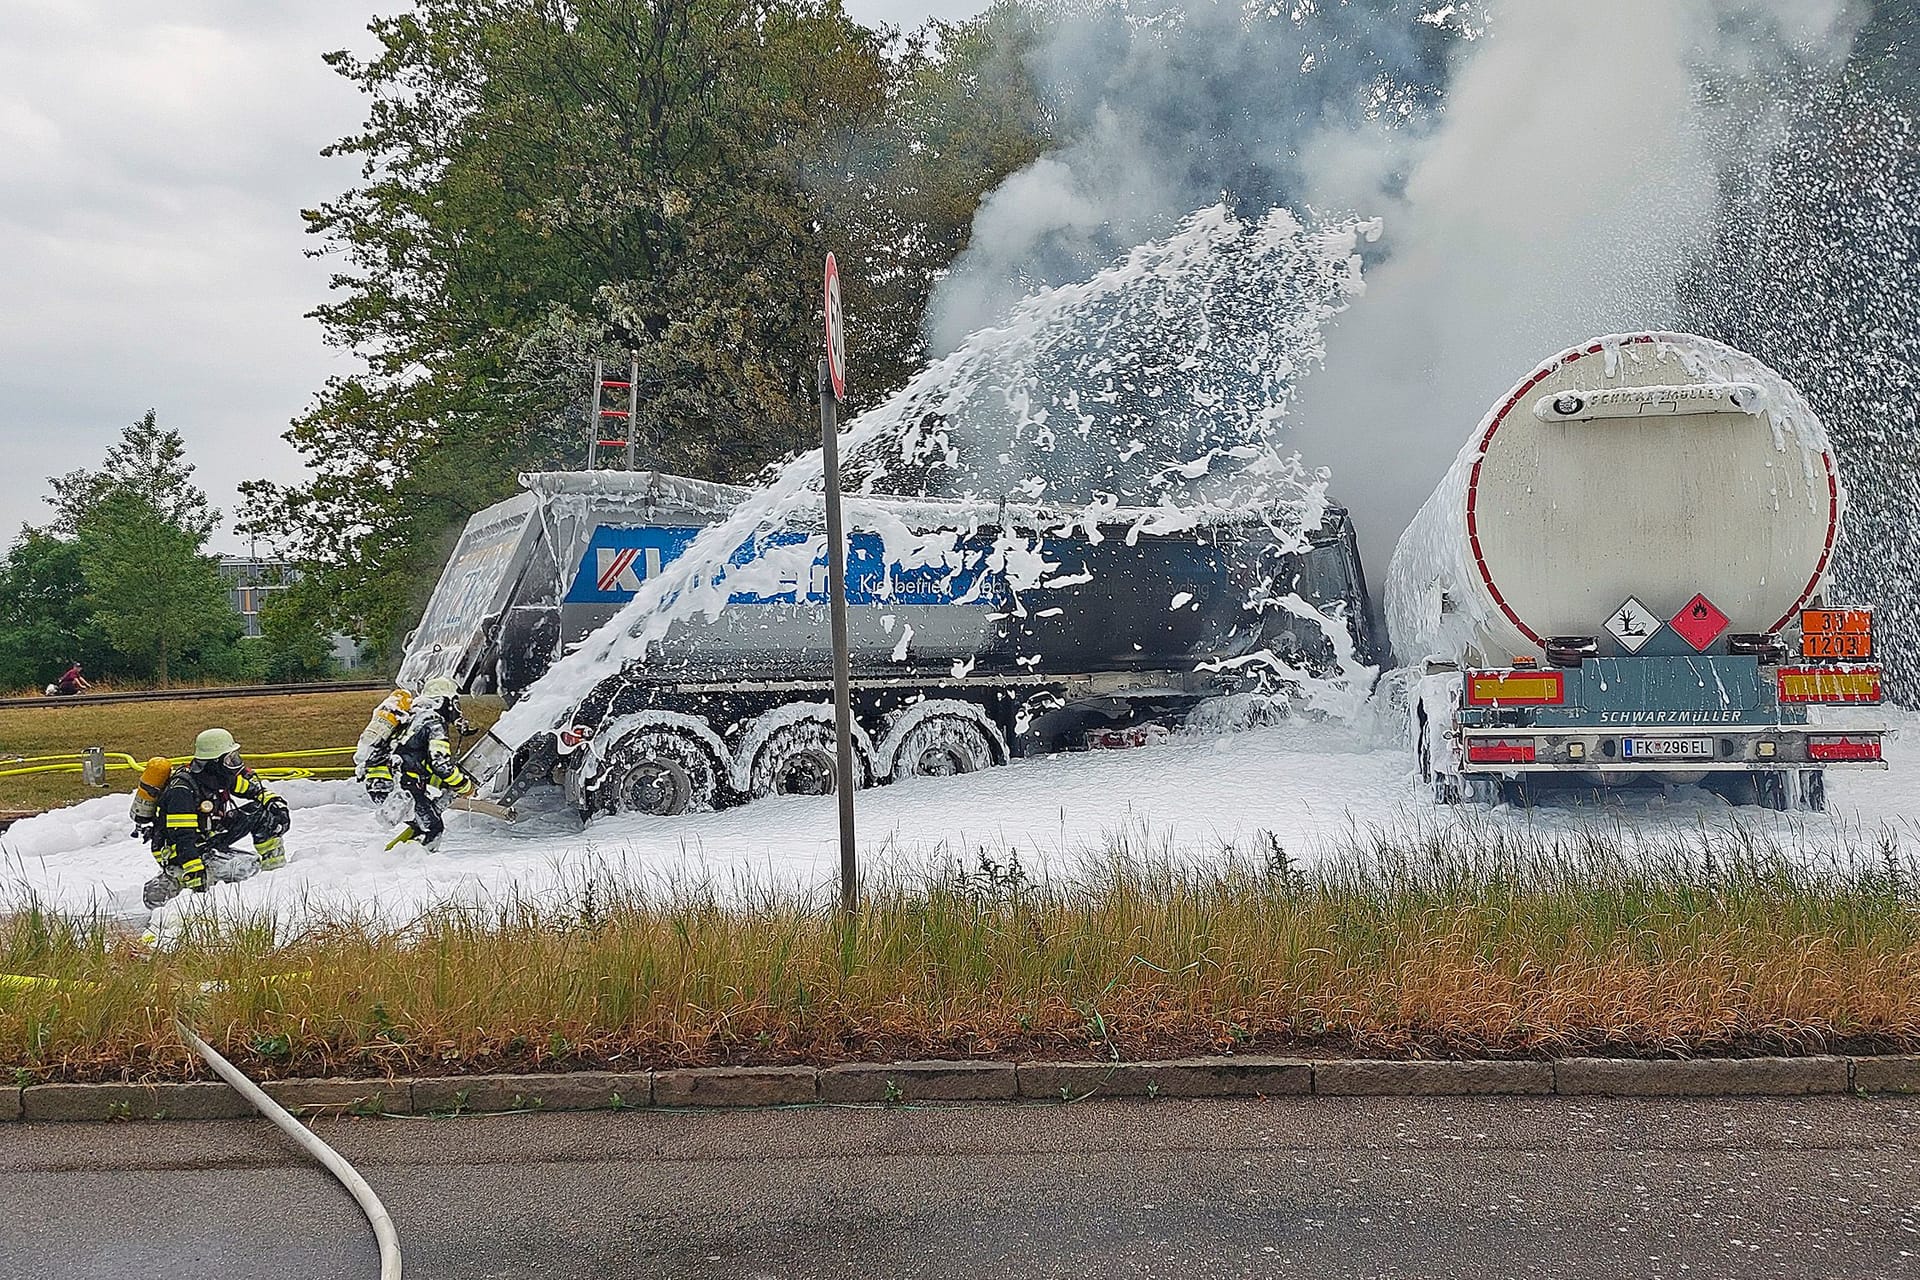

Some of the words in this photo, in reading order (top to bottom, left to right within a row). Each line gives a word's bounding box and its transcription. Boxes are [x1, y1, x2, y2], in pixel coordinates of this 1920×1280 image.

[1590, 388, 1724, 406] SCHWARMÜLLE
[1810, 637, 1858, 654] 1203
[1600, 711, 1742, 722] SCHWARZMÜLLER
[1636, 741, 1653, 754] FK
